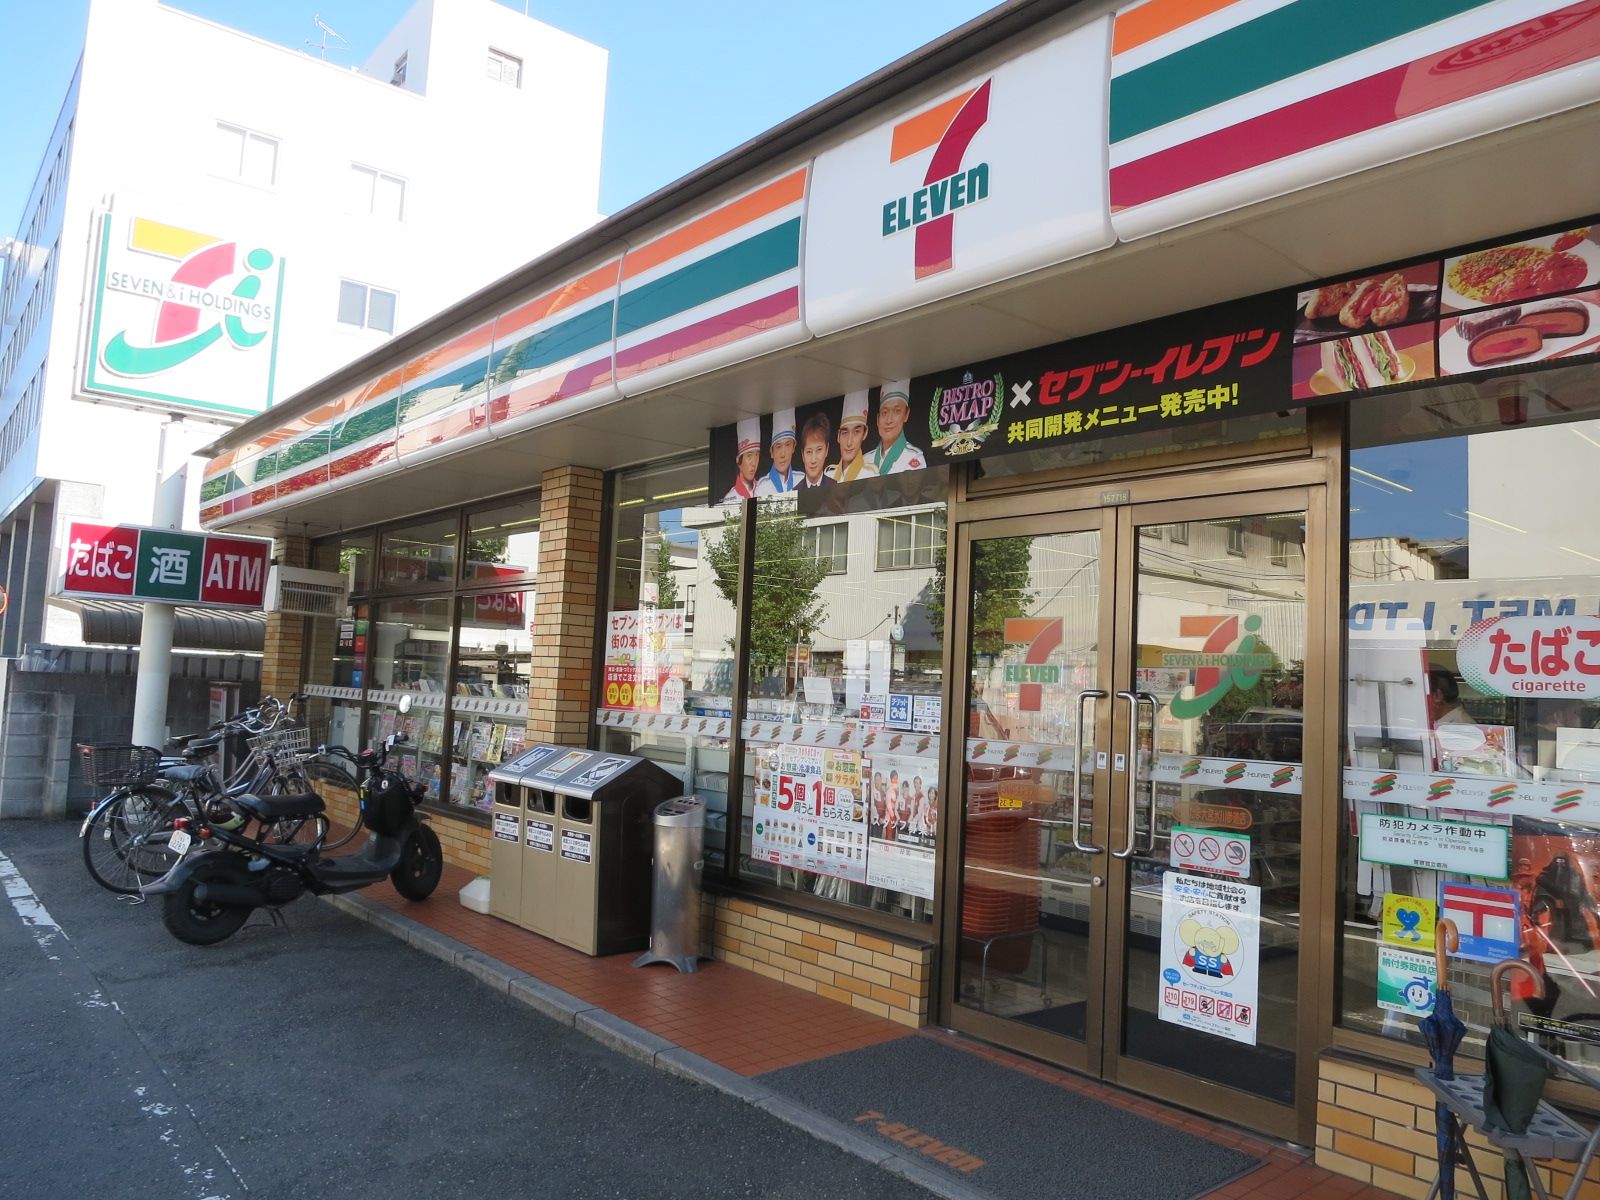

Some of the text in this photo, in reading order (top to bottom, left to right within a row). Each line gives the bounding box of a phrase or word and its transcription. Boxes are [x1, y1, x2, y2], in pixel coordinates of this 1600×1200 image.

[189, 291, 272, 321] HOLDINGS
[942, 379, 995, 406] BISTRO
[938, 397, 994, 426] SMAP
[68, 541, 262, 592] たばこ 酒 ATM
[1511, 679, 1587, 693] cigarette
[1379, 818, 1487, 839] 防犯カメラ作動中
[1198, 955, 1218, 969] SS
